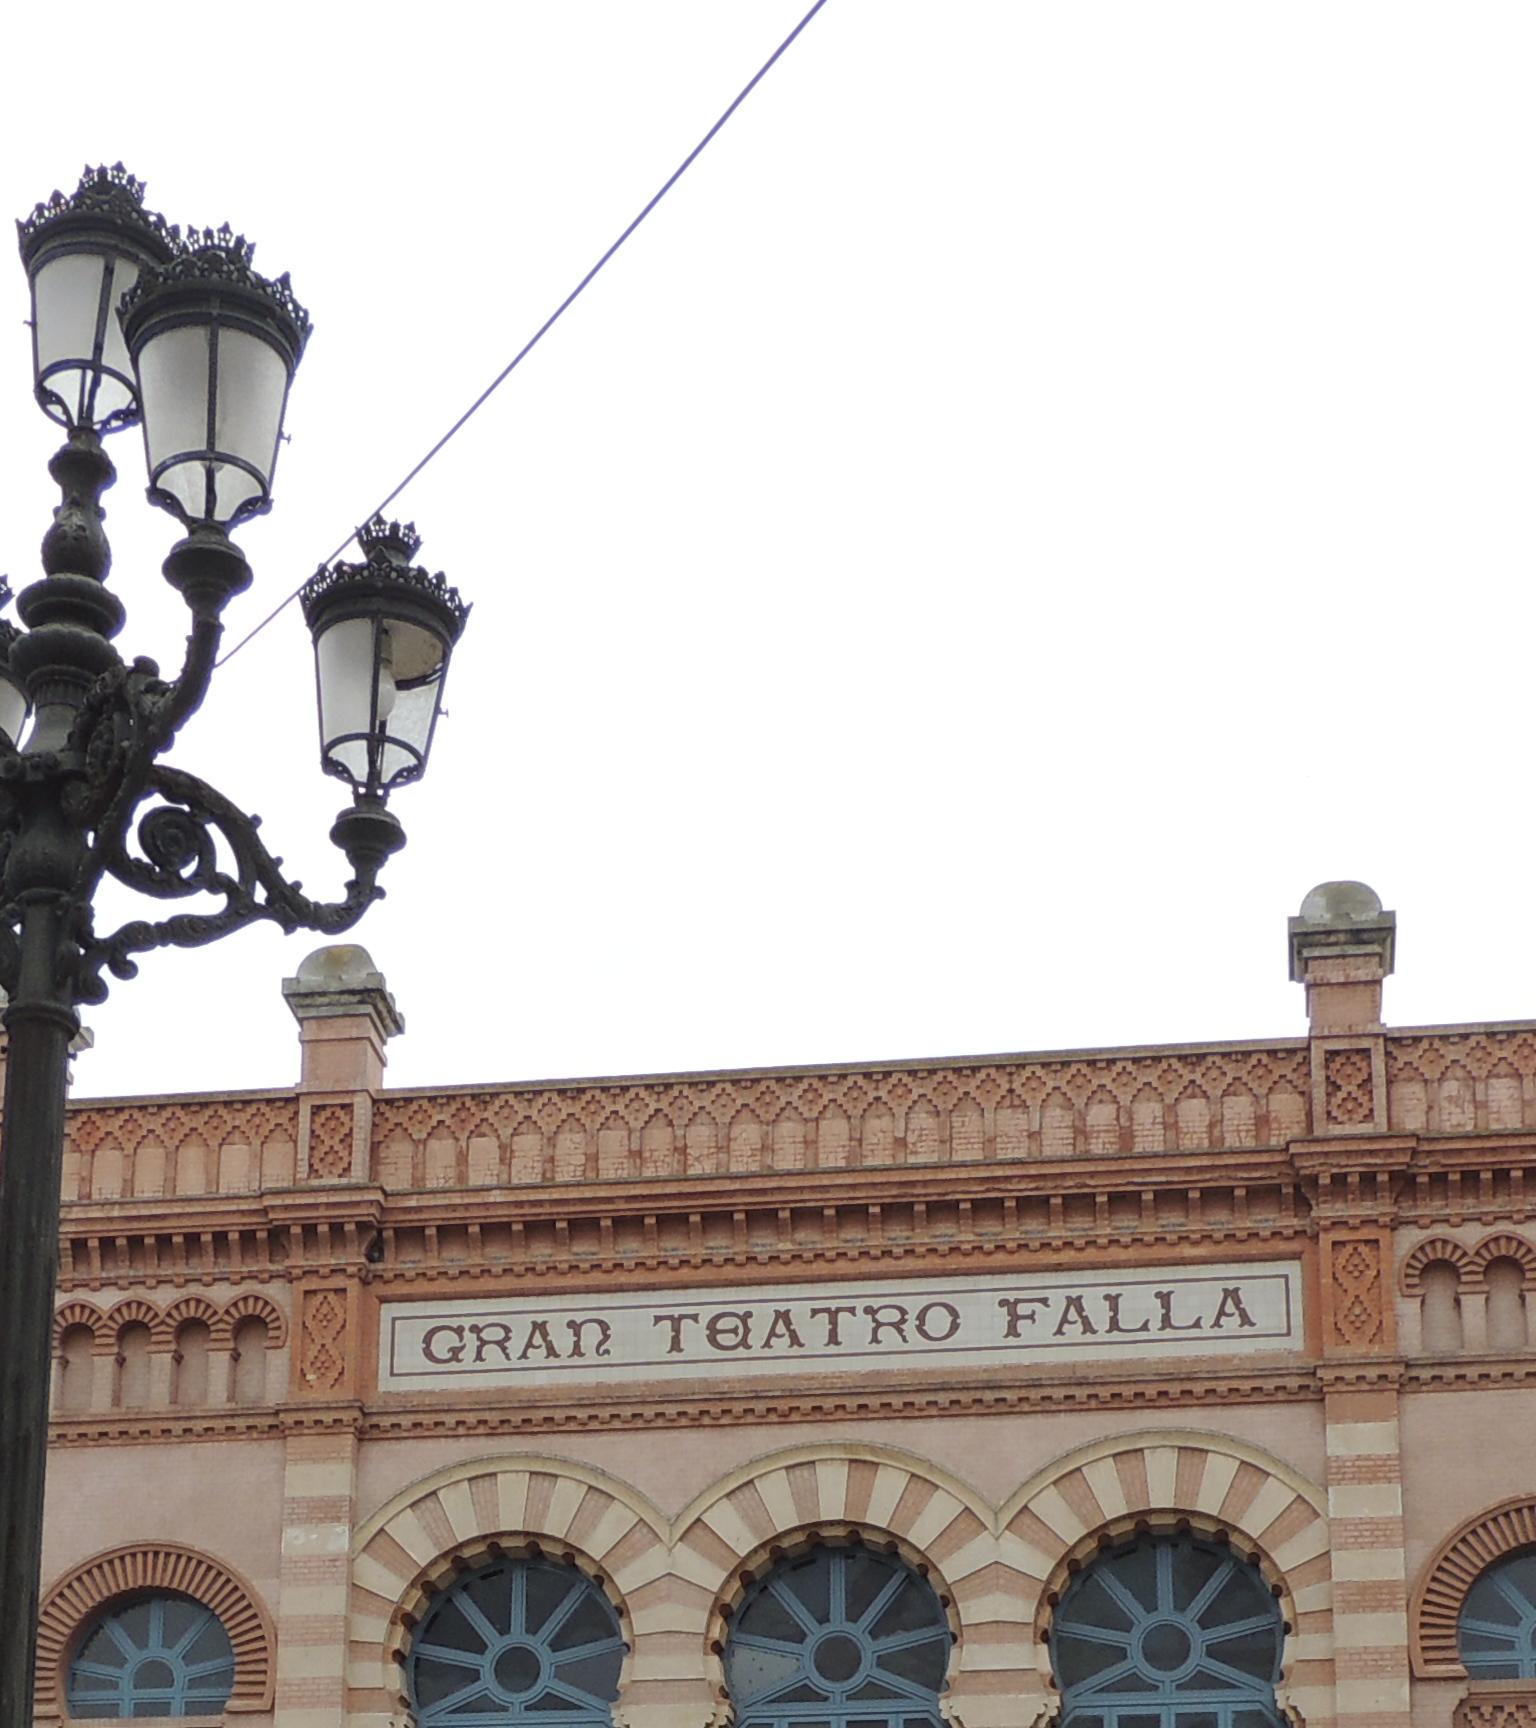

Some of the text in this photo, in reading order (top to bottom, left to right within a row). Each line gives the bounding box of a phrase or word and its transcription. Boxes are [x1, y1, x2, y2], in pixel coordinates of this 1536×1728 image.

[420, 1286, 1257, 1365] GRAN TEATRO FALLA
